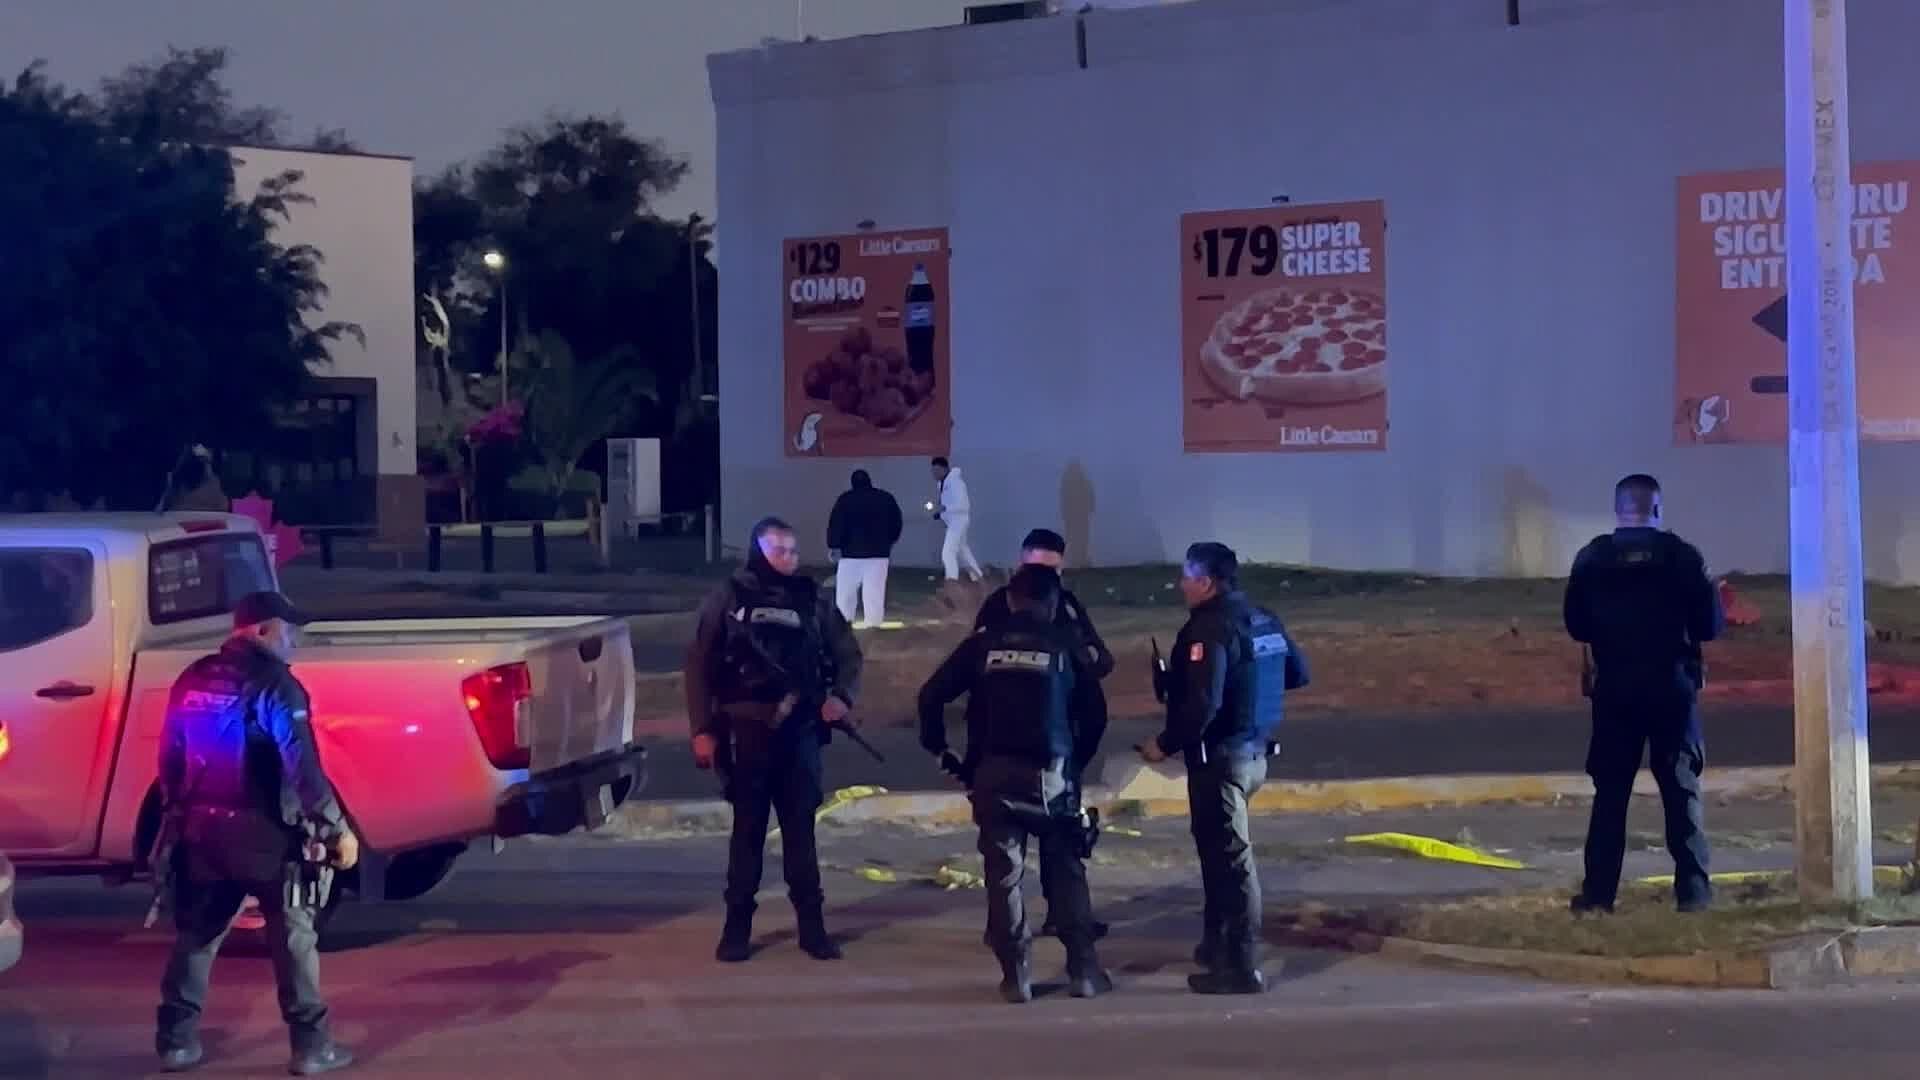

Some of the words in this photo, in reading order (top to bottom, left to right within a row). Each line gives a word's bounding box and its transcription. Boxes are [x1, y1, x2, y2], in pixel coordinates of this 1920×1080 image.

[1699, 188, 1786, 223] DRIV
[1280, 221, 1361, 251] SUPER
[1714, 216, 1893, 257] SIGUTE
[1281, 248, 1371, 277] CHEESE
[790, 276, 866, 302] COMBO
